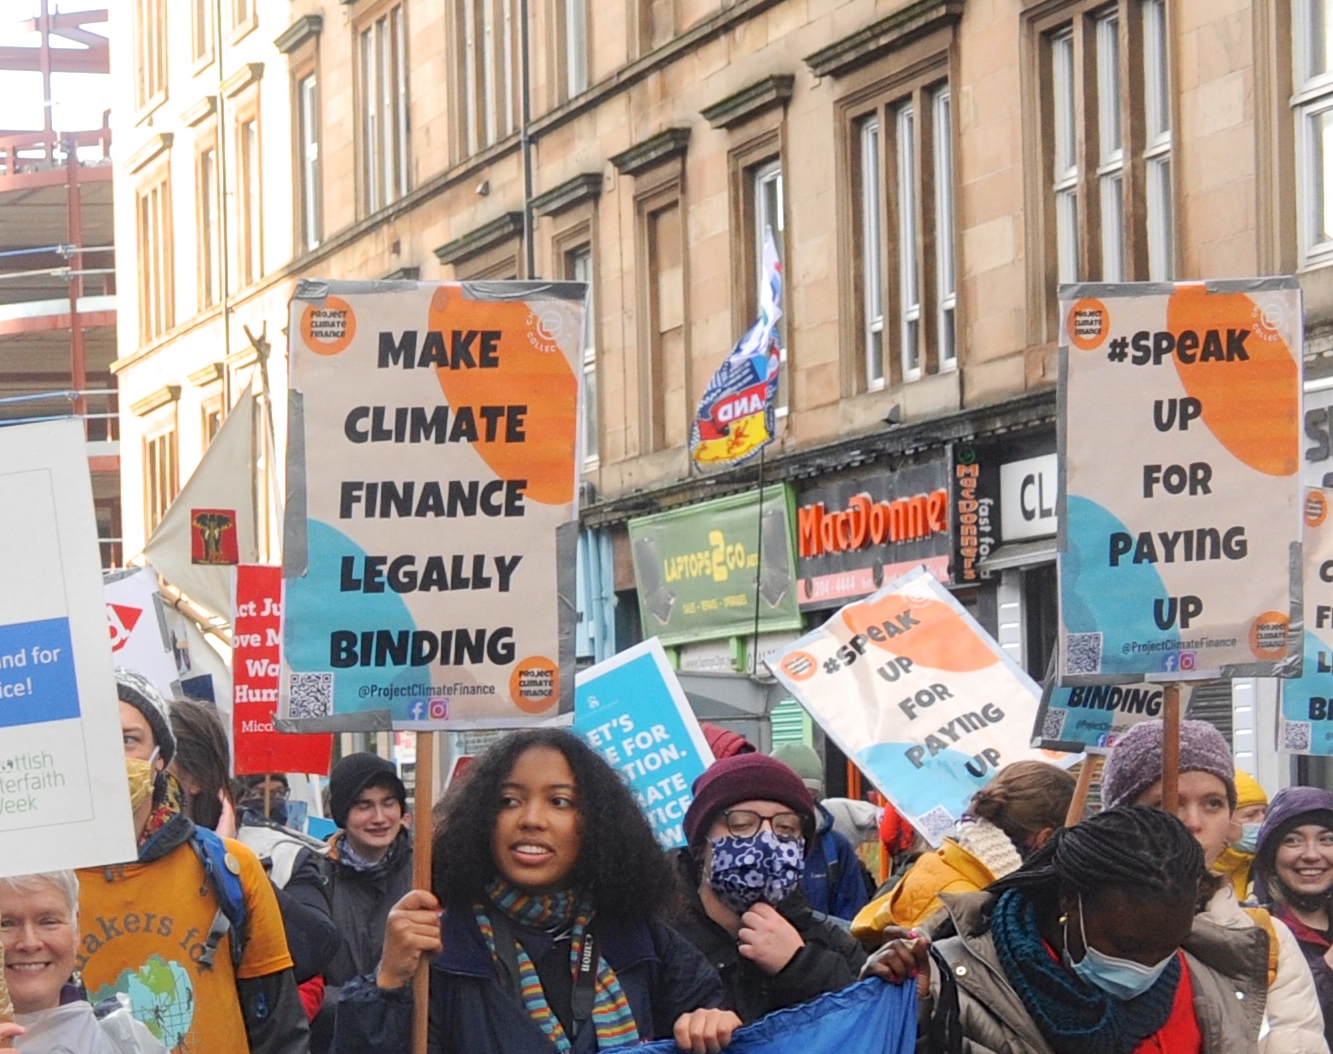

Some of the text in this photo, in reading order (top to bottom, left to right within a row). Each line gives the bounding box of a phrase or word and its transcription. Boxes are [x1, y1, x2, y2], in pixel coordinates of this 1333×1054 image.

[377, 329, 502, 370] MAKE
[344, 405, 528, 445] CLIMATE
[1153, 396, 1202, 433] UP
[1020, 472, 1057, 521] CL
[1143, 461, 1212, 499] FOR
[339, 479, 528, 519] FINANCE
[979, 498, 994, 532] fast
[798, 488, 948, 557] MacDonne
[340, 554, 524, 594] LEGALLY
[1153, 595, 1203, 631] UP
[31, 646, 61, 665] for
[234, 632, 260, 647] ove
[330, 626, 517, 669] BINDING
[1121, 637, 1237, 656] @ProjectClimateFinance
[877, 656, 914, 683] UP
[358, 681, 496, 700] @ProjectClimateFinance
[898, 683, 954, 721] FOR
[1067, 686, 1164, 717] BINDING
[242, 720, 275, 733] Mica
[586, 713, 635, 749] ET'S
[622, 723, 670, 757] FOR
[622, 743, 687, 782] TION.
[964, 747, 1001, 778] UP
[75, 912, 174, 972] uakers
[581, 933, 594, 972] Canon
